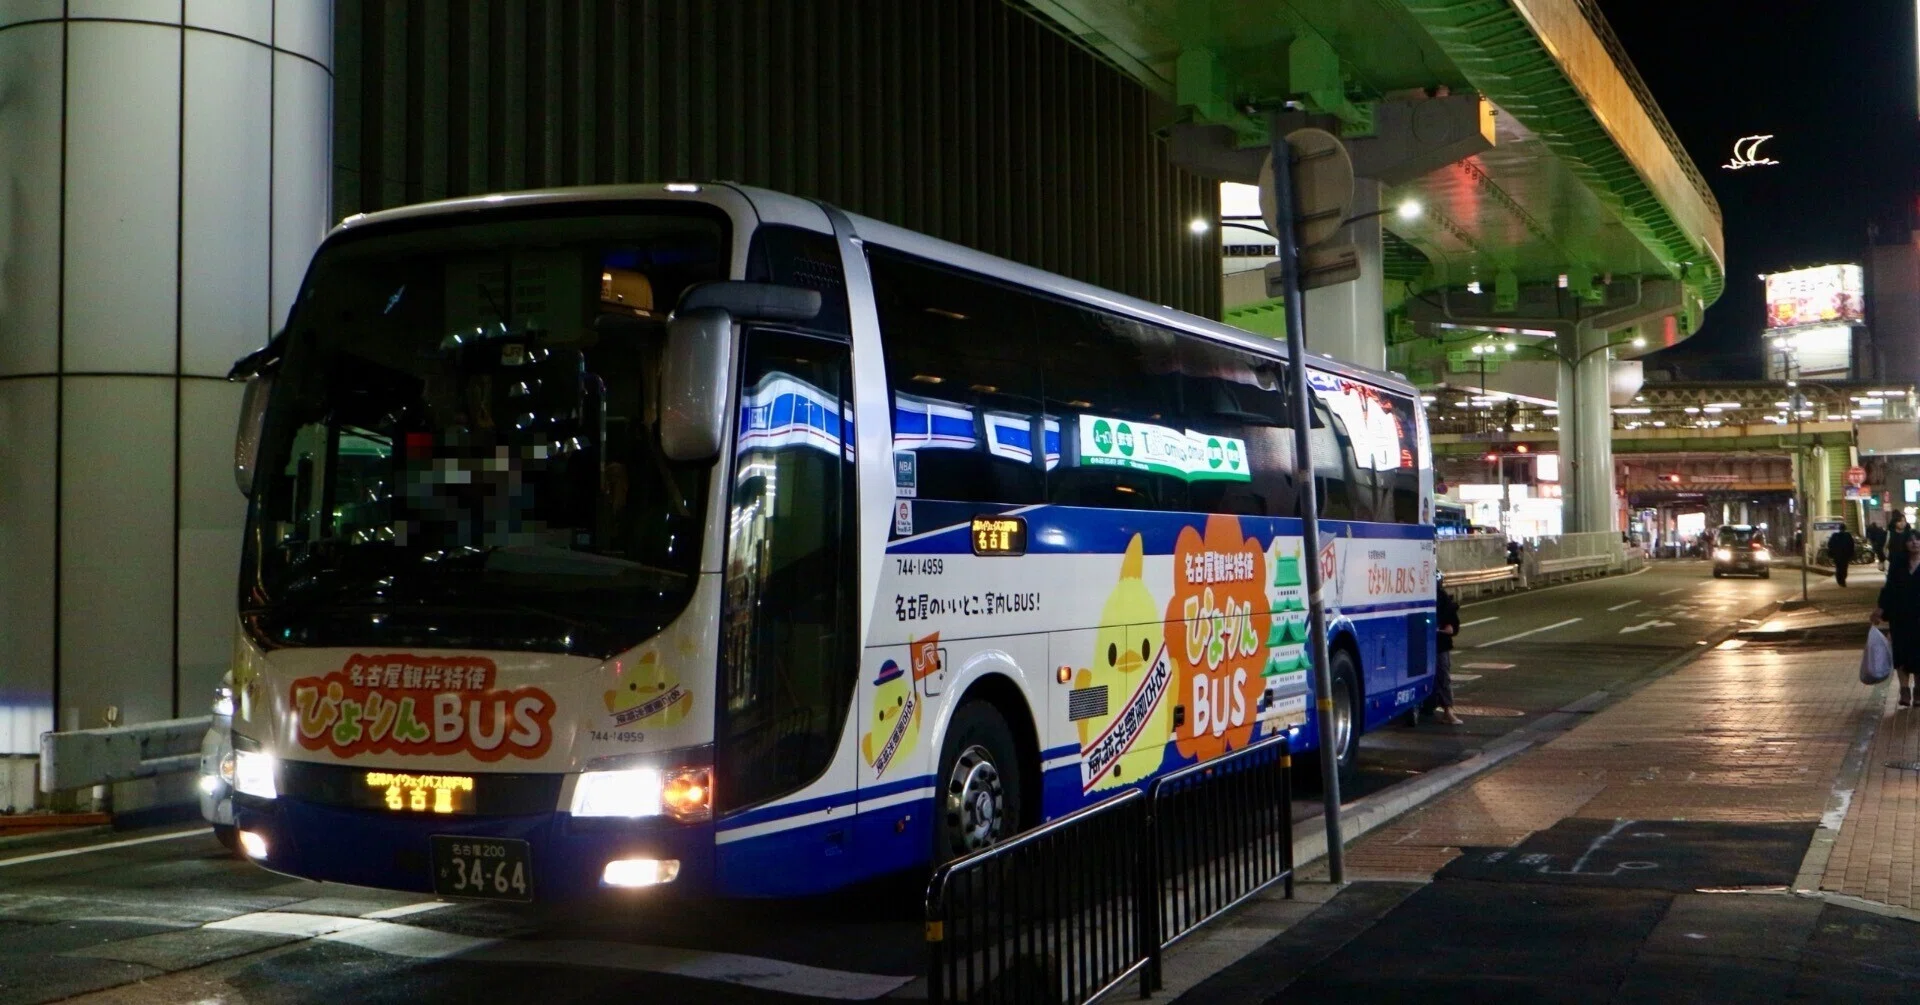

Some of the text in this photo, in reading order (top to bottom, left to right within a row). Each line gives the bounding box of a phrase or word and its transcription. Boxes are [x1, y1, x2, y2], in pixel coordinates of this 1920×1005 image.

[978, 531, 1009, 549] 名古屋
[897, 559, 943, 575] 744-14959
[1185, 551, 1254, 584] 名古屋観光特使
[351, 664, 486, 690] 名古屋観光特使
[1193, 667, 1248, 737] BUS
[385, 786, 453, 813] 名古屋
[452, 858, 526, 895] 34-64
